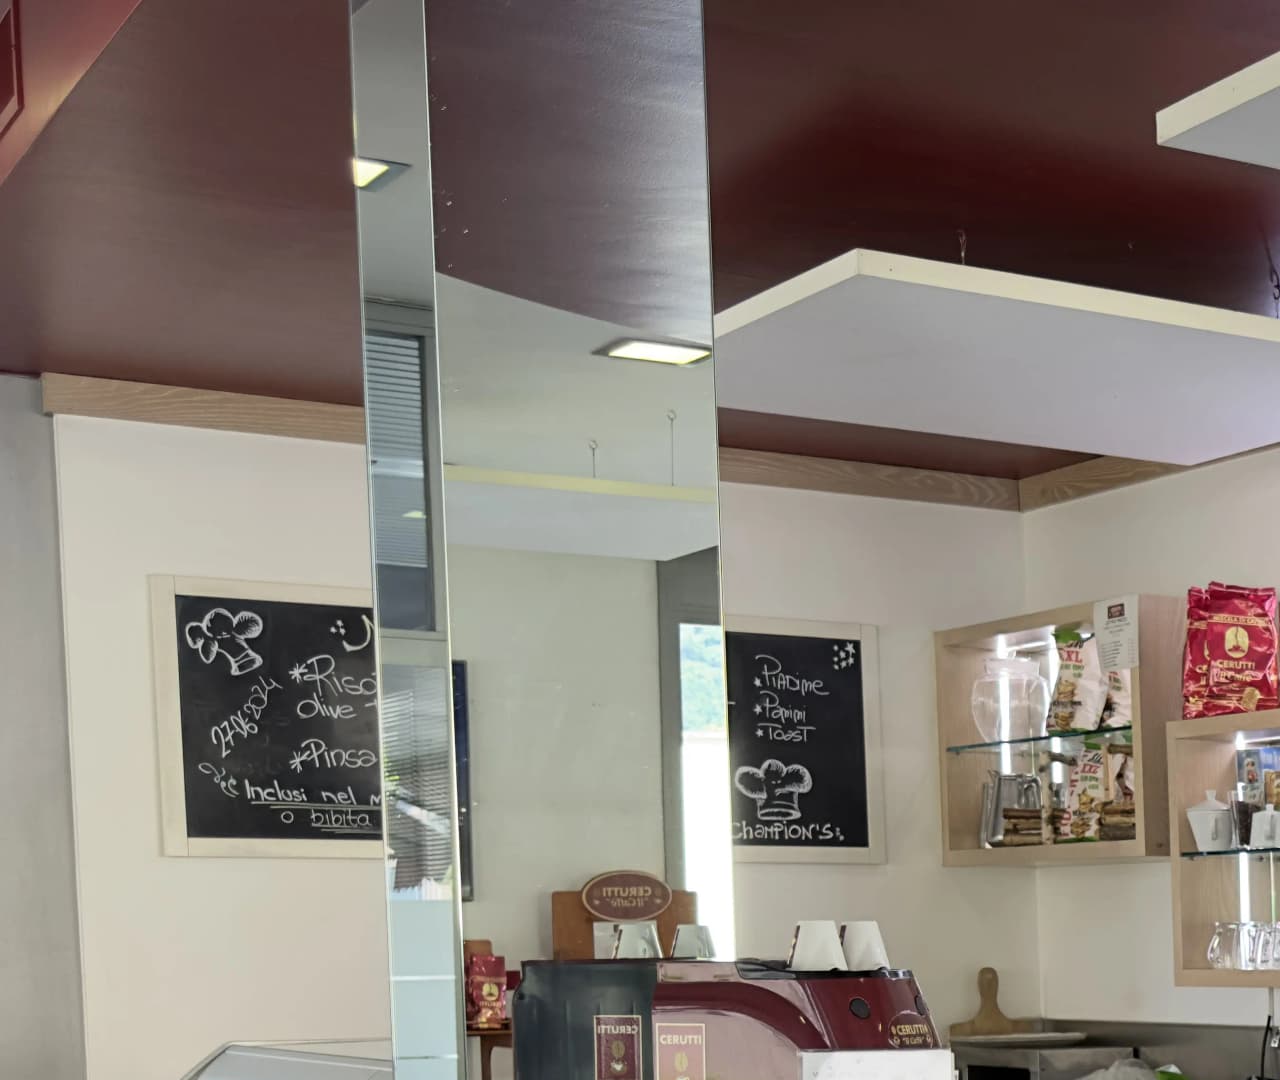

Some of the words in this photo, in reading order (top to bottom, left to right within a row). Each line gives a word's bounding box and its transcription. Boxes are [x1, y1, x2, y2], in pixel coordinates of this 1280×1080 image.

[245, 779, 308, 801] Inclusi
[322, 786, 356, 805] nel
[660, 1035, 702, 1045] CERUTTI
